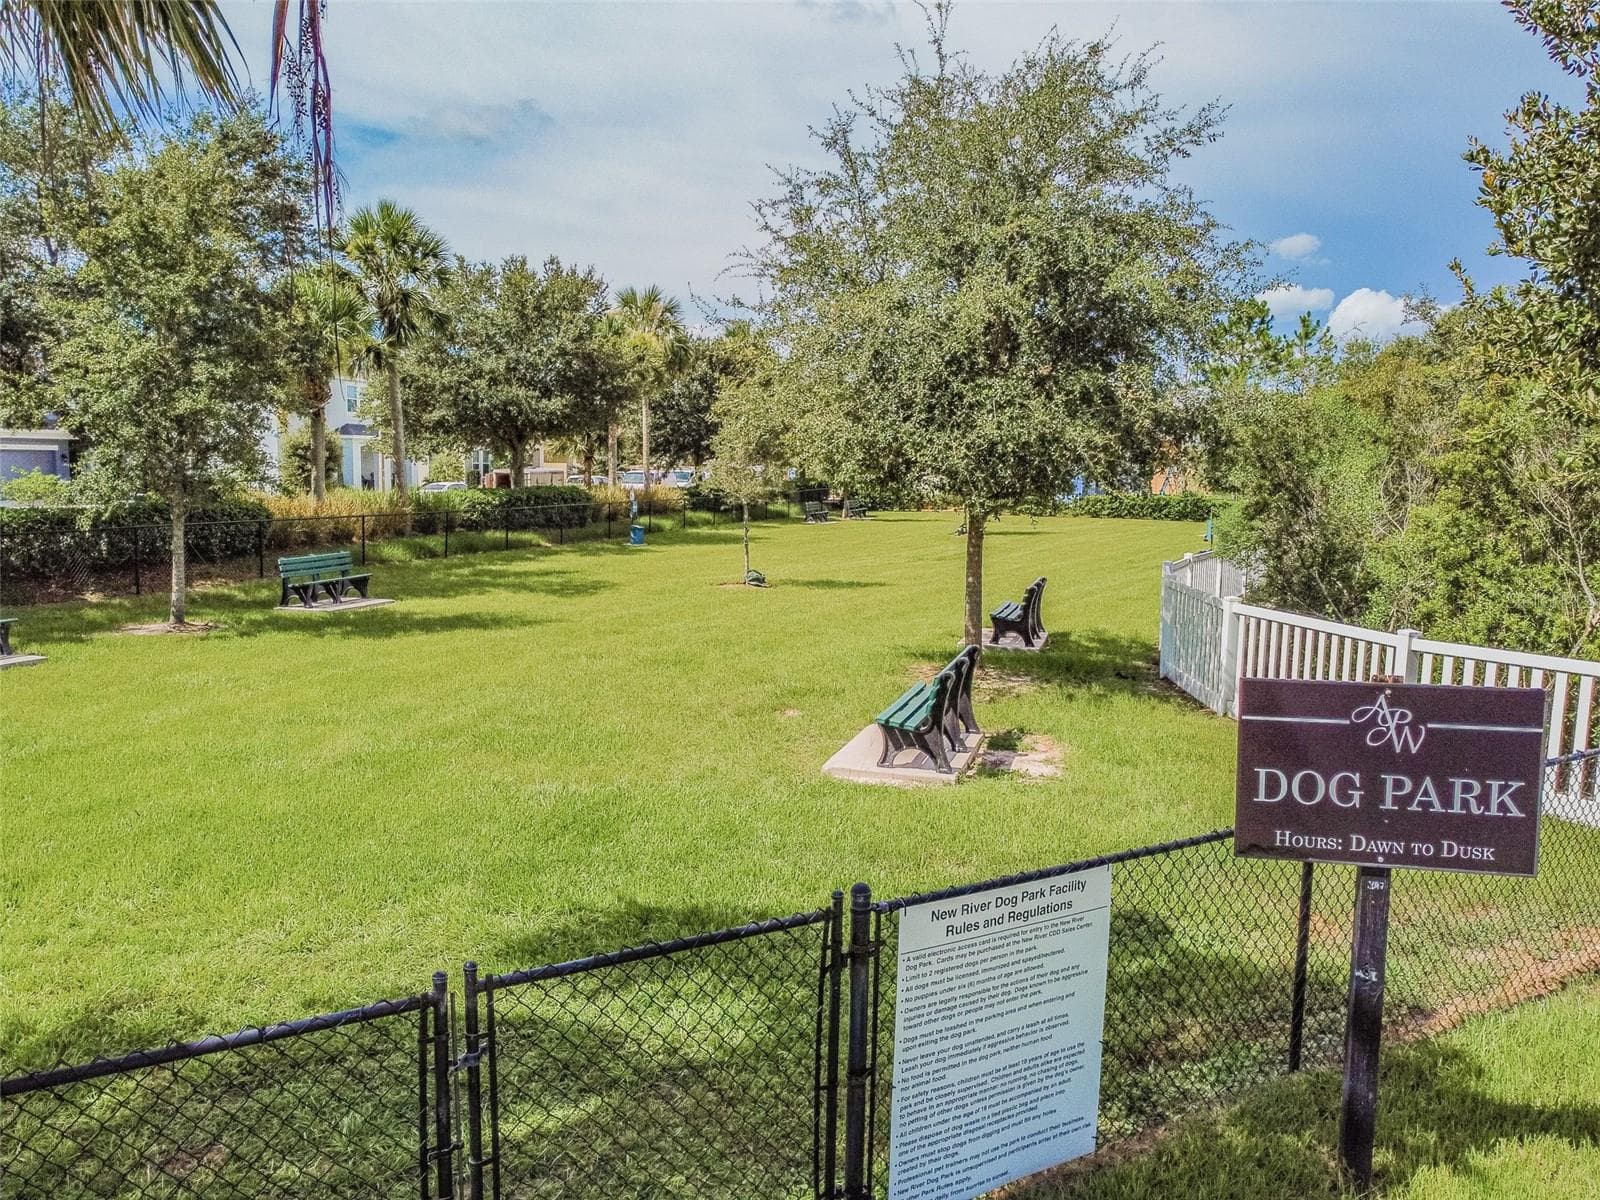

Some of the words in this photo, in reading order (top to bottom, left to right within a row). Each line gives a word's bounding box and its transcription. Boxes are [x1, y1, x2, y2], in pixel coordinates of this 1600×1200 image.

[1253, 768, 1364, 808] DOG
[1379, 775, 1526, 817] PARK
[1349, 834, 1405, 854] DAWN
[1411, 843, 1434, 856] TO
[1441, 841, 1495, 861] DUSK
[931, 908, 957, 922] New
[961, 898, 992, 916] River
[995, 894, 1018, 908] Dog
[1021, 888, 1046, 903] Park
[1049, 879, 1087, 897] Facility
[945, 921, 980, 937] Rules
[983, 914, 1005, 929] and
[1008, 898, 1073, 923] Regulations
